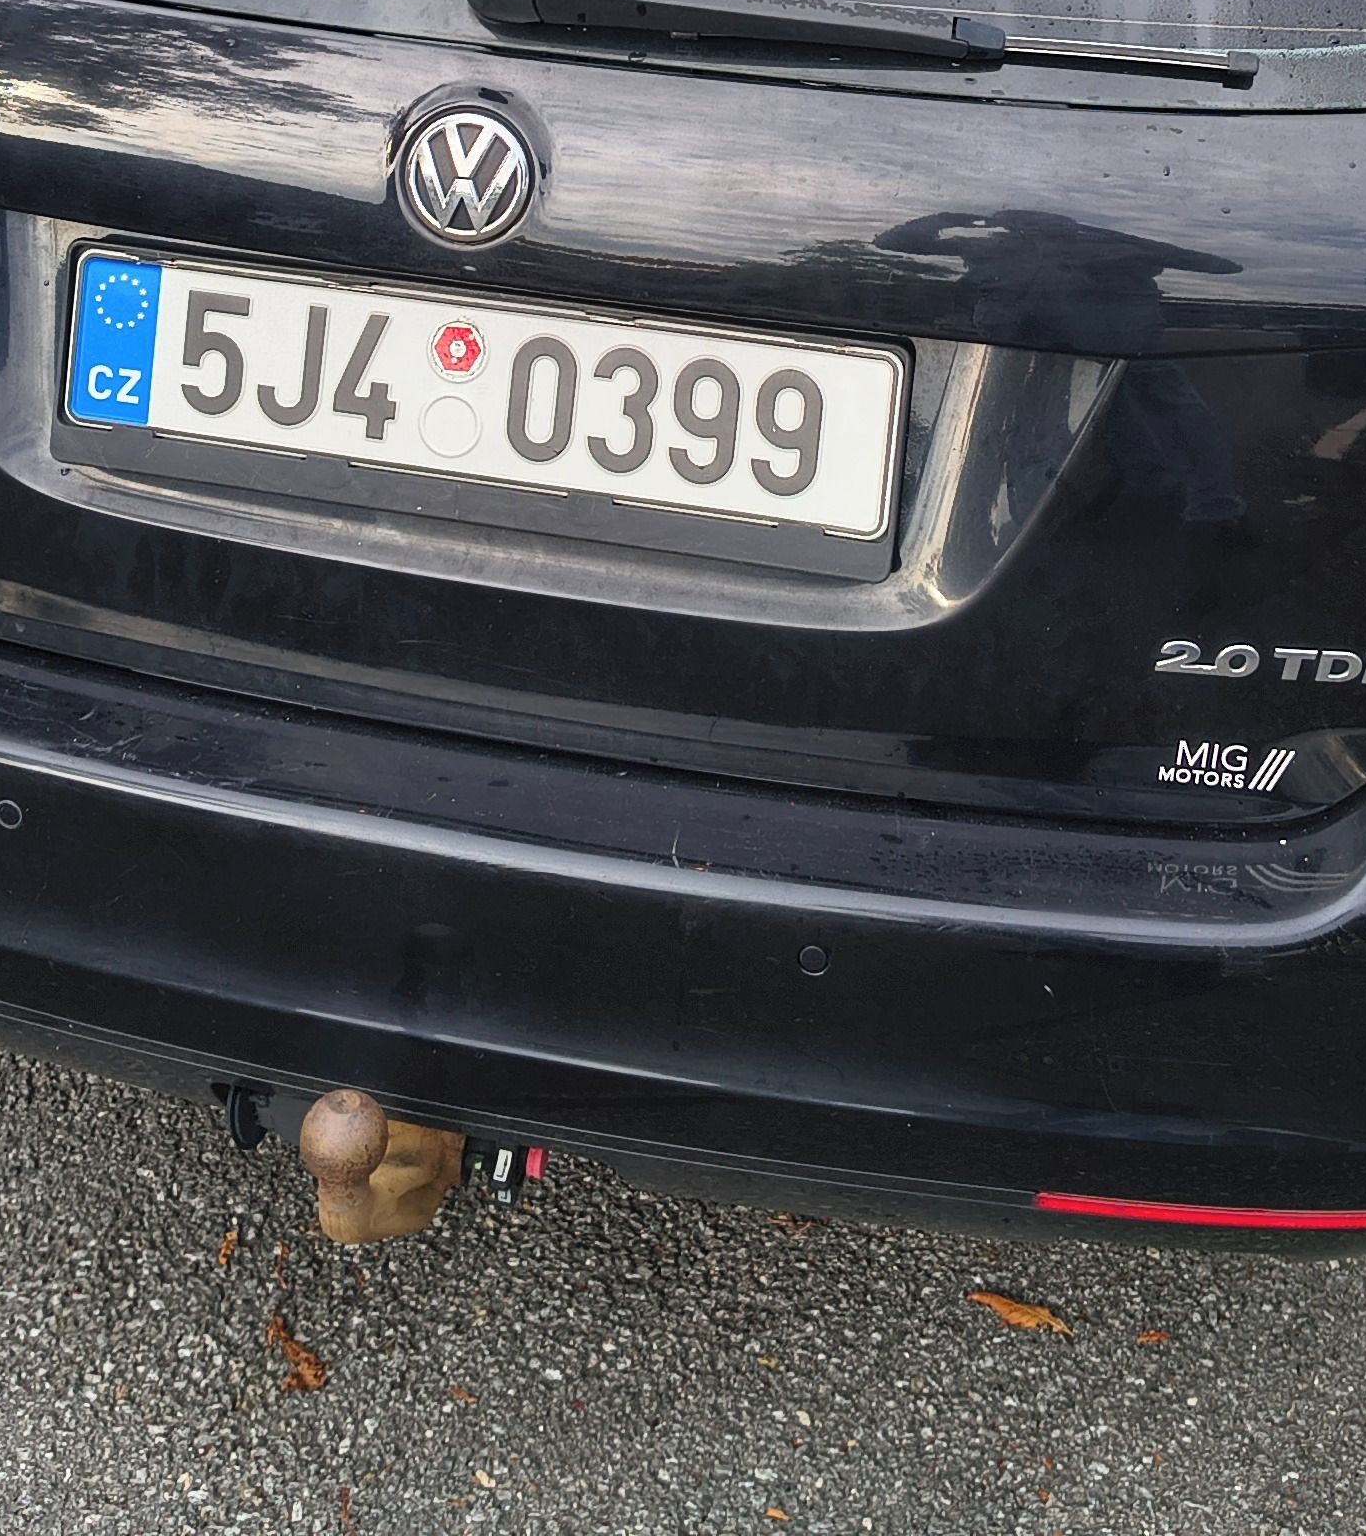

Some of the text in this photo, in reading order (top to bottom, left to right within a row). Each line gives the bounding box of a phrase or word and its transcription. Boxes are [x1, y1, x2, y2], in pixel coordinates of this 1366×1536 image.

[88, 288, 825, 498] CZ 5J4 0399
[1176, 740, 1248, 771] MIG
[1158, 766, 1245, 789] MOTORS
